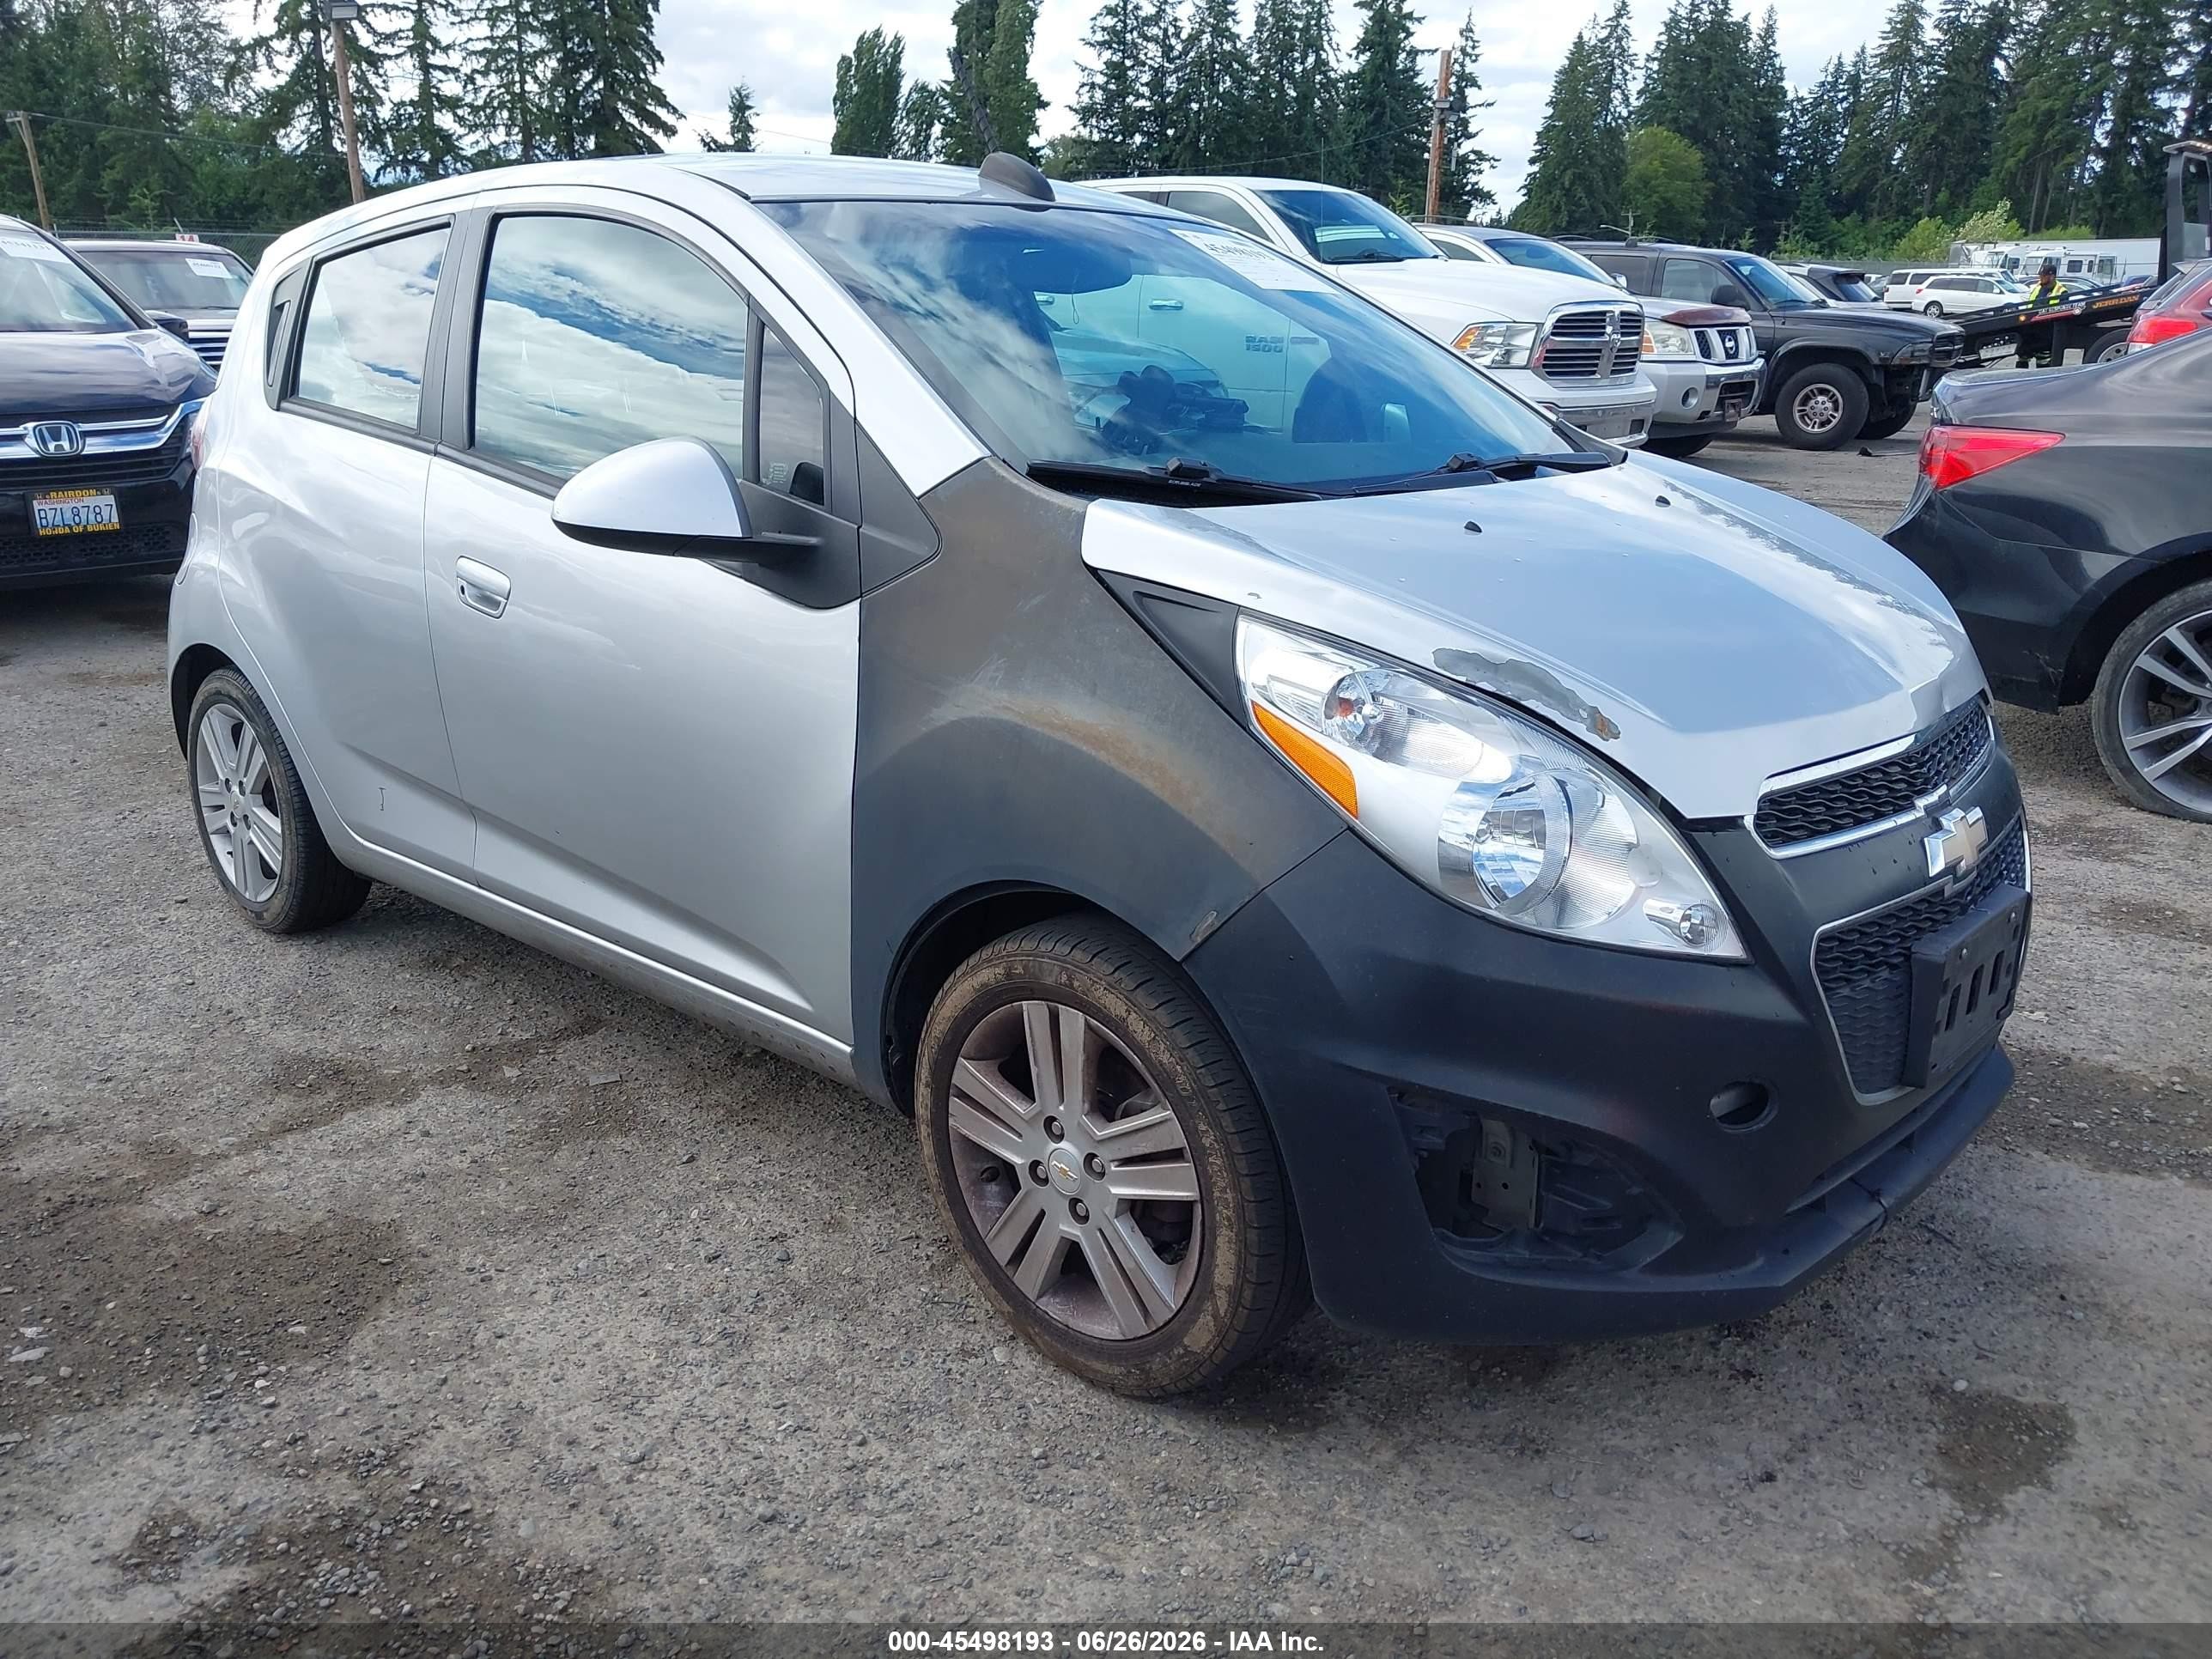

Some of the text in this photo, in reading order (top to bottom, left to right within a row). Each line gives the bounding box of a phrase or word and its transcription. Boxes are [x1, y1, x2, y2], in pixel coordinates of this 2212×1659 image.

[1245, 343, 1284, 353] 1500
[50, 489, 97, 499] RAIRDON
[38, 504, 113, 527] BZL8787
[39, 522, 120, 536] HONDA OF BURIEN
